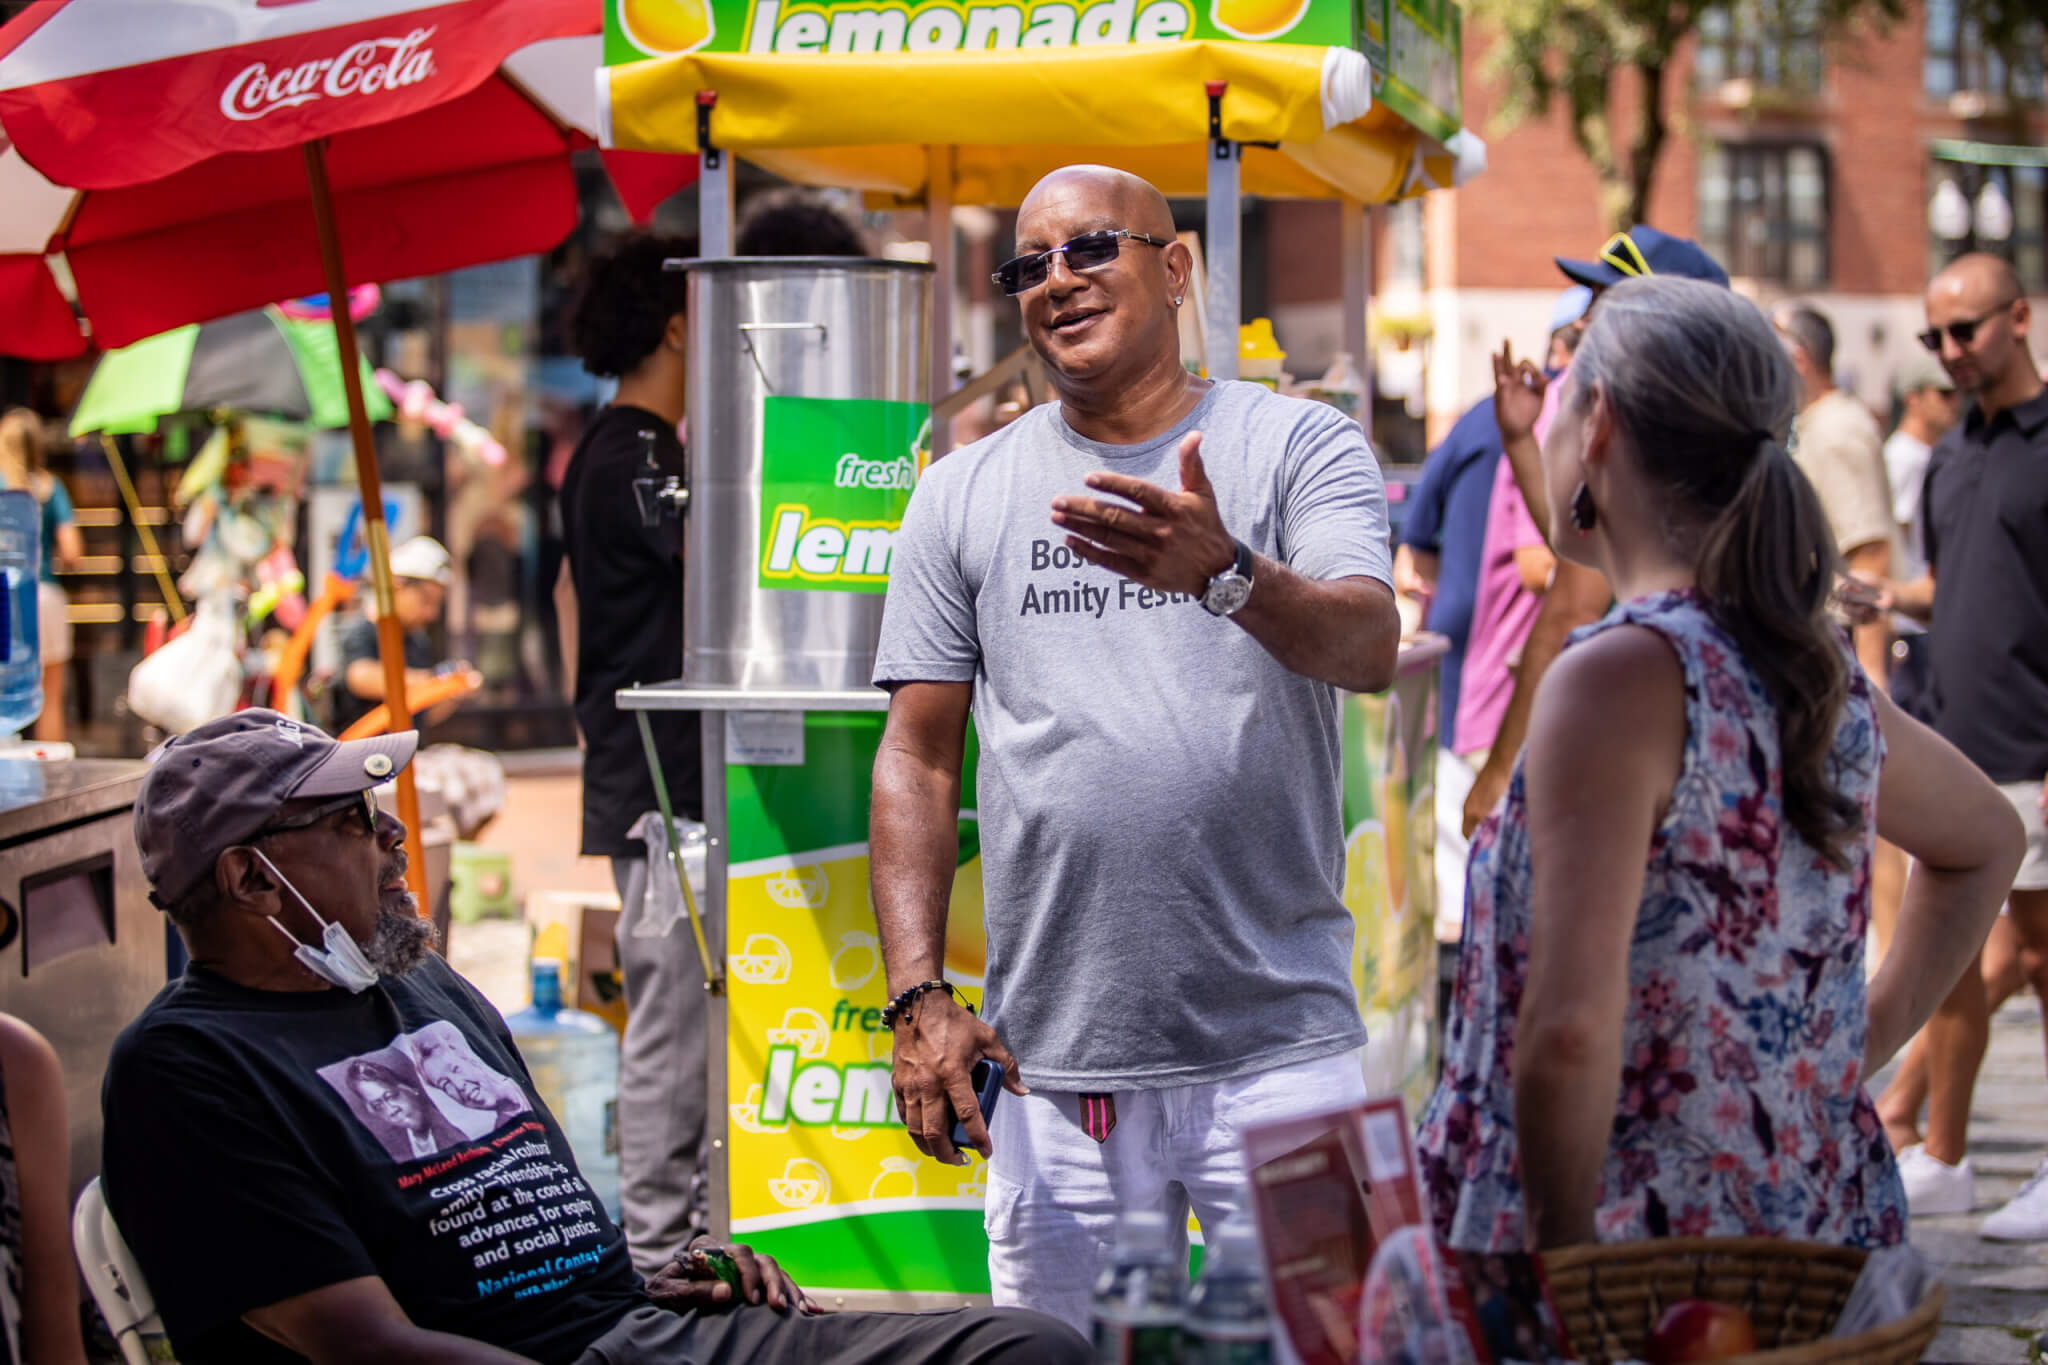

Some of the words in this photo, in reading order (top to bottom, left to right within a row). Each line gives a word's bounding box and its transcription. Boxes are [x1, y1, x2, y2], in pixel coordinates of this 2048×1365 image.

[744, 0, 1192, 54] lemonade
[220, 25, 437, 121] Coca-Cola
[837, 454, 914, 489] fresh
[1019, 580, 1110, 619] Amity
[397, 1173, 423, 1189] Mary
[430, 1177, 476, 1198] Cross
[429, 1201, 487, 1236] found
[491, 1195, 512, 1213] at
[513, 1187, 536, 1206] the
[536, 1183, 562, 1200] core
[458, 1211, 539, 1248] advances
[537, 1204, 561, 1223] for
[562, 1198, 596, 1217] equity
[473, 1240, 511, 1270] and
[513, 1226, 560, 1256] social
[559, 1219, 602, 1247] justice.
[476, 1259, 551, 1297] National
